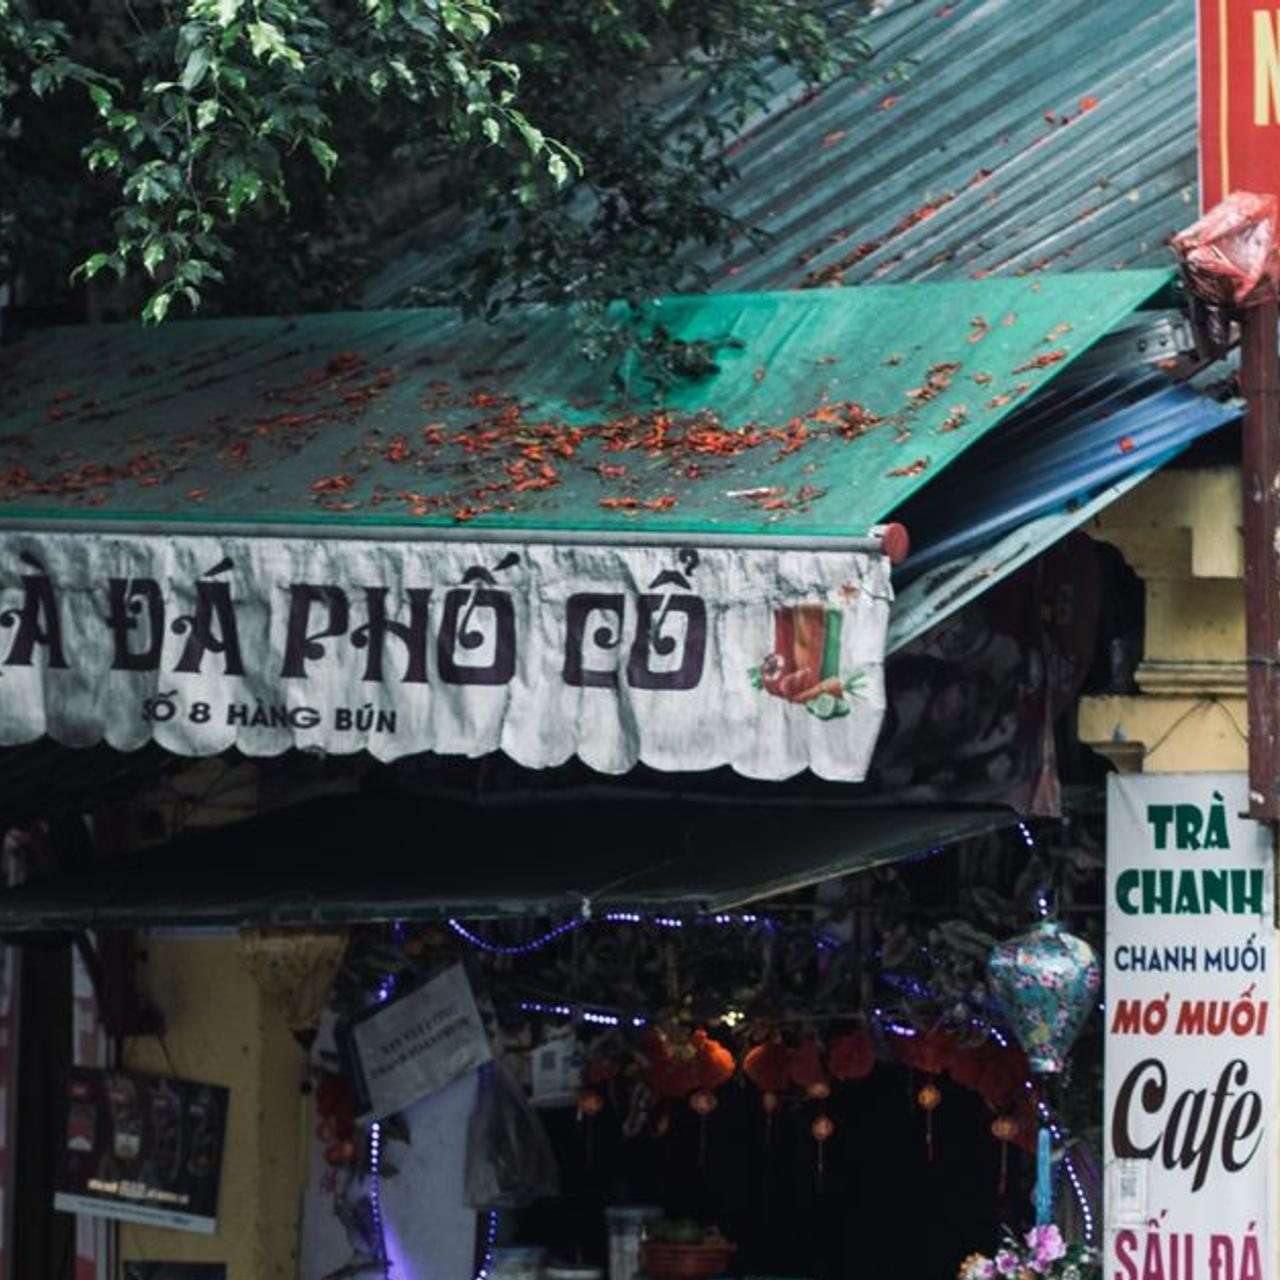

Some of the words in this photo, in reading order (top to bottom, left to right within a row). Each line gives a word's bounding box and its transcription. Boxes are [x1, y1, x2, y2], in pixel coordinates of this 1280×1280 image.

[106, 557, 247, 677] ĐÁ
[280, 551, 520, 686] PHỐ
[562, 548, 708, 691] CỔ
[142, 689, 179, 723] SỐ
[188, 702, 212, 724] 8
[227, 697, 320, 729] HÀNG
[335, 700, 397, 734] BÚN
[1147, 790, 1231, 851] TRÀ
[1114, 868, 1265, 916] CHANH
[1114, 945, 1197, 973] CHANH
[1204, 932, 1266, 973] MUỐI
[1111, 992, 1171, 1036] MƠ
[1175, 982, 1269, 1037] MUỐI
[1112, 1057, 1264, 1193] Cafe
